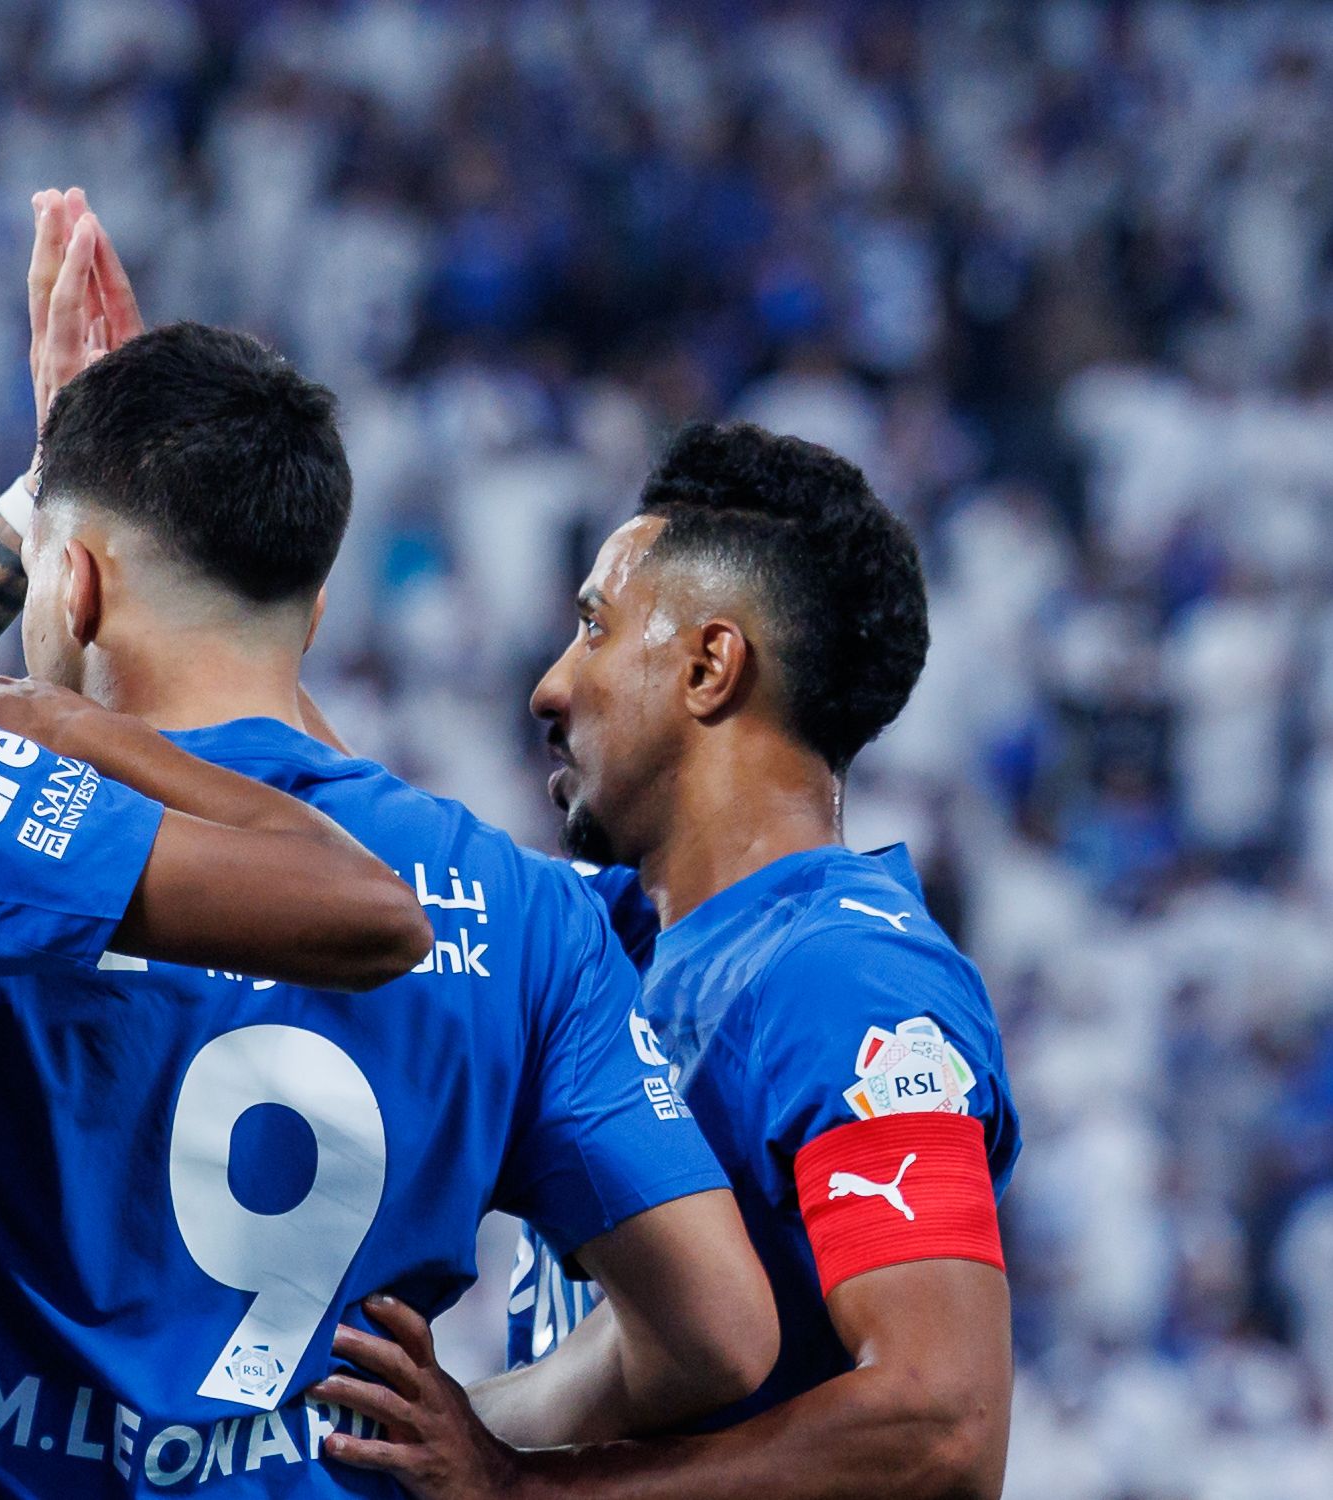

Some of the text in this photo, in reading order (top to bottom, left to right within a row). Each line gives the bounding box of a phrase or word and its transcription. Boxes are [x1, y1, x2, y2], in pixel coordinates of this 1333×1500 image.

[33, 757, 85, 824] SAN
[60, 766, 100, 830] INVEST
[894, 1072, 942, 1098] RSL
[170, 1024, 387, 1411] 9
[243, 1365, 265, 1377] RSL
